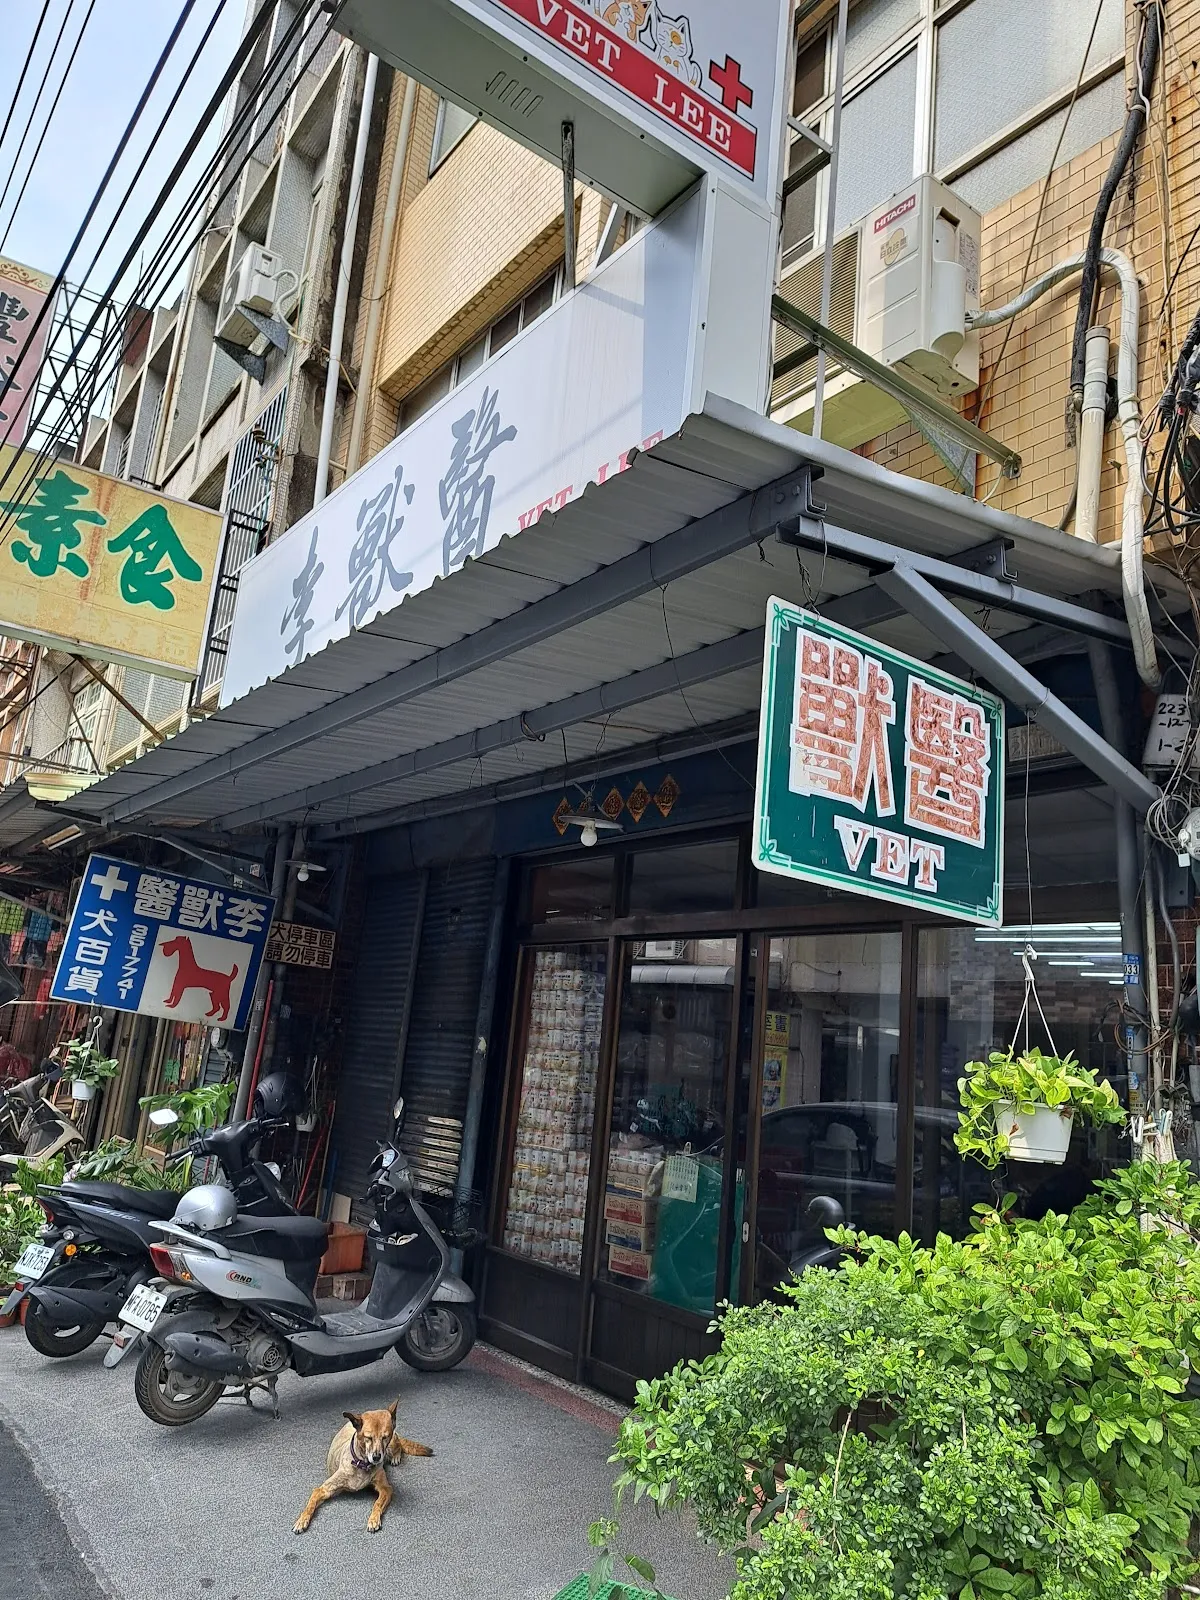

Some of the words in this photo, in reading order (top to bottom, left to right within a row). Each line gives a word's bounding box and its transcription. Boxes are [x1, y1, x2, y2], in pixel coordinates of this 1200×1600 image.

[535, 0, 622, 72] VET
[652, 74, 732, 153] LEE
[876, 198, 914, 230] HITACHI
[0, 469, 204, 610] 素食
[789, 627, 992, 850] 獸醫
[834, 814, 945, 894] VET
[64, 910, 119, 997] 犬百貨
[266, 941, 332, 967] 請勿停車
[270, 923, 335, 949] 犬停車區
